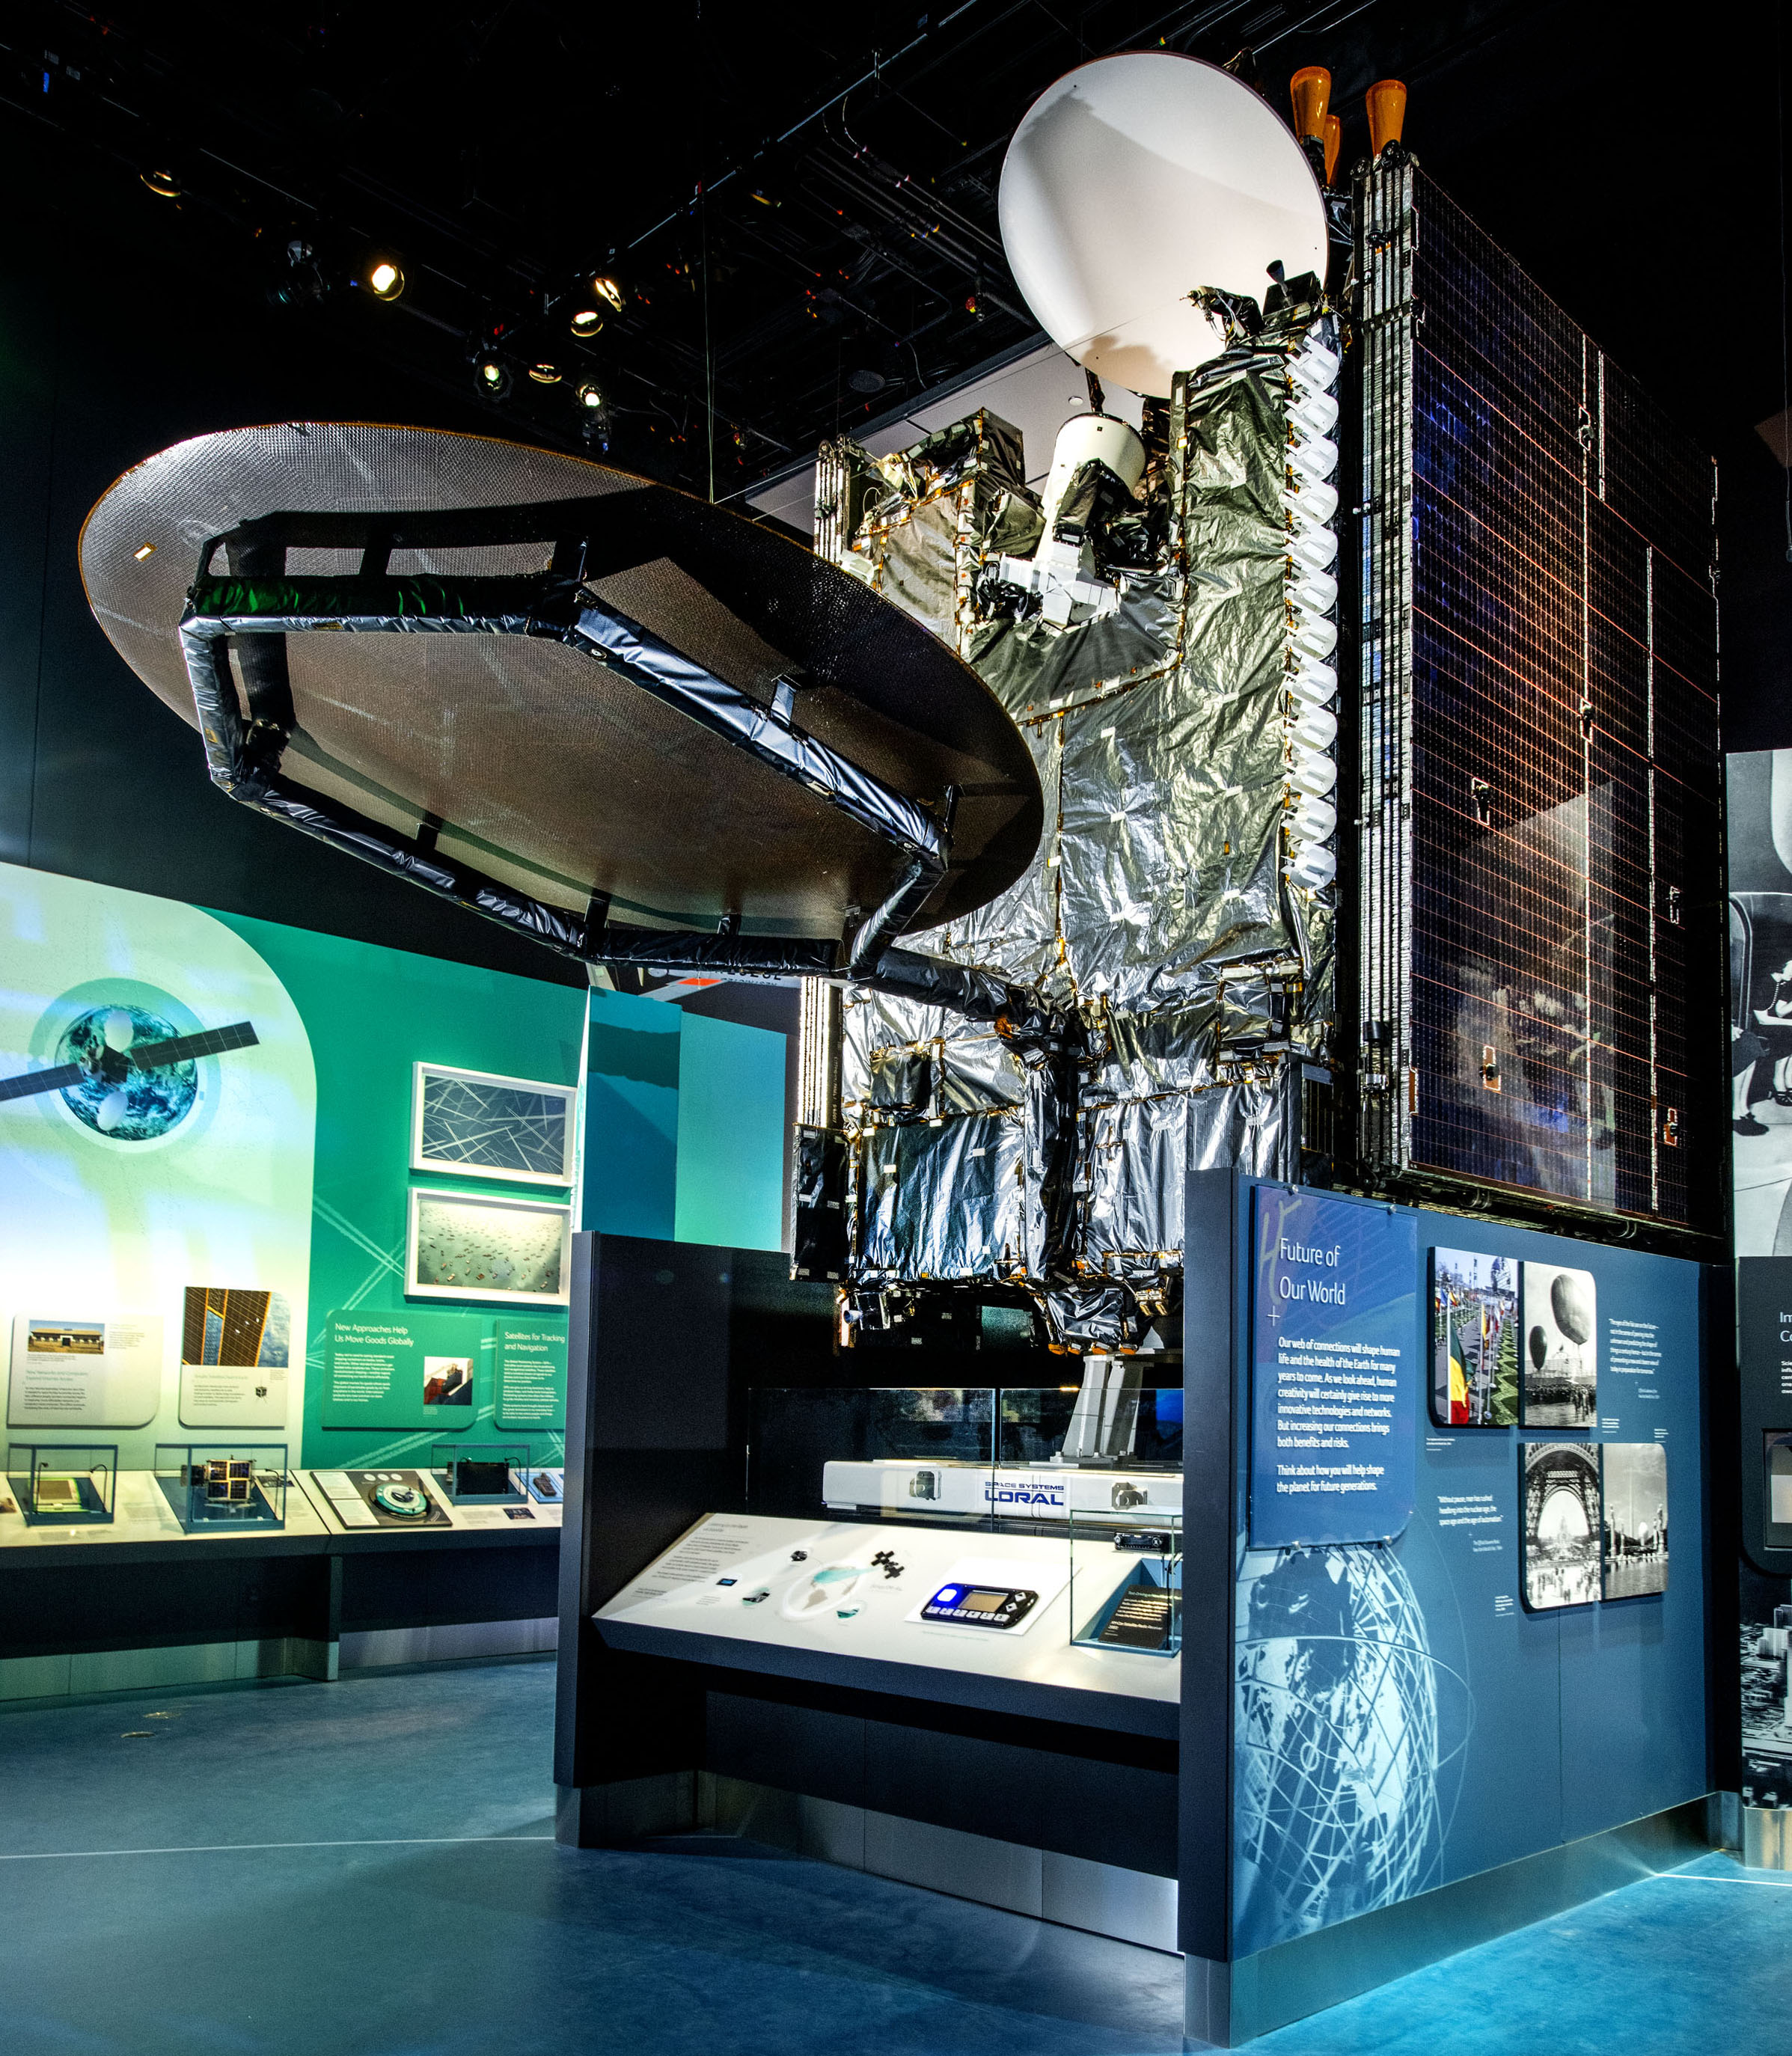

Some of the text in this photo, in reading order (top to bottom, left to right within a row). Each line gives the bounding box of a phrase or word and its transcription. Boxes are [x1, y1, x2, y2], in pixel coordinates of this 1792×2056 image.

[1280, 1237, 1341, 1267] Future of
[1279, 1276, 1346, 1305] Our World
[334, 1323, 409, 1336] New Approaches Help
[345, 1336, 364, 1344] Move
[365, 1336, 387, 1344] Goods
[388, 1337, 414, 1347] Globally
[504, 1332, 566, 1344] Satellites for Tracking
[517, 1344, 548, 1353] Navigation
[1279, 1336, 1401, 1357] Our web of connections will shape human
[1278, 1353, 1396, 1374] life and the health of the Earth for many
[1278, 1372, 1397, 1387] years to come. As we look ahead, human
[1278, 1387, 1395, 1404] creativity will certainly give rise to more
[1277, 1403, 1392, 1419] innovative technologies and networks.
[1277, 1419, 1390, 1436] But increasing our connections brings
[1277, 1436, 1350, 1448] both benefits and risks.
[1276, 1463, 1384, 1478] Think about how you will help shape
[1276, 1480, 1377, 1495] the planet for future generations.
[985, 1490, 1064, 1506] LORAL
